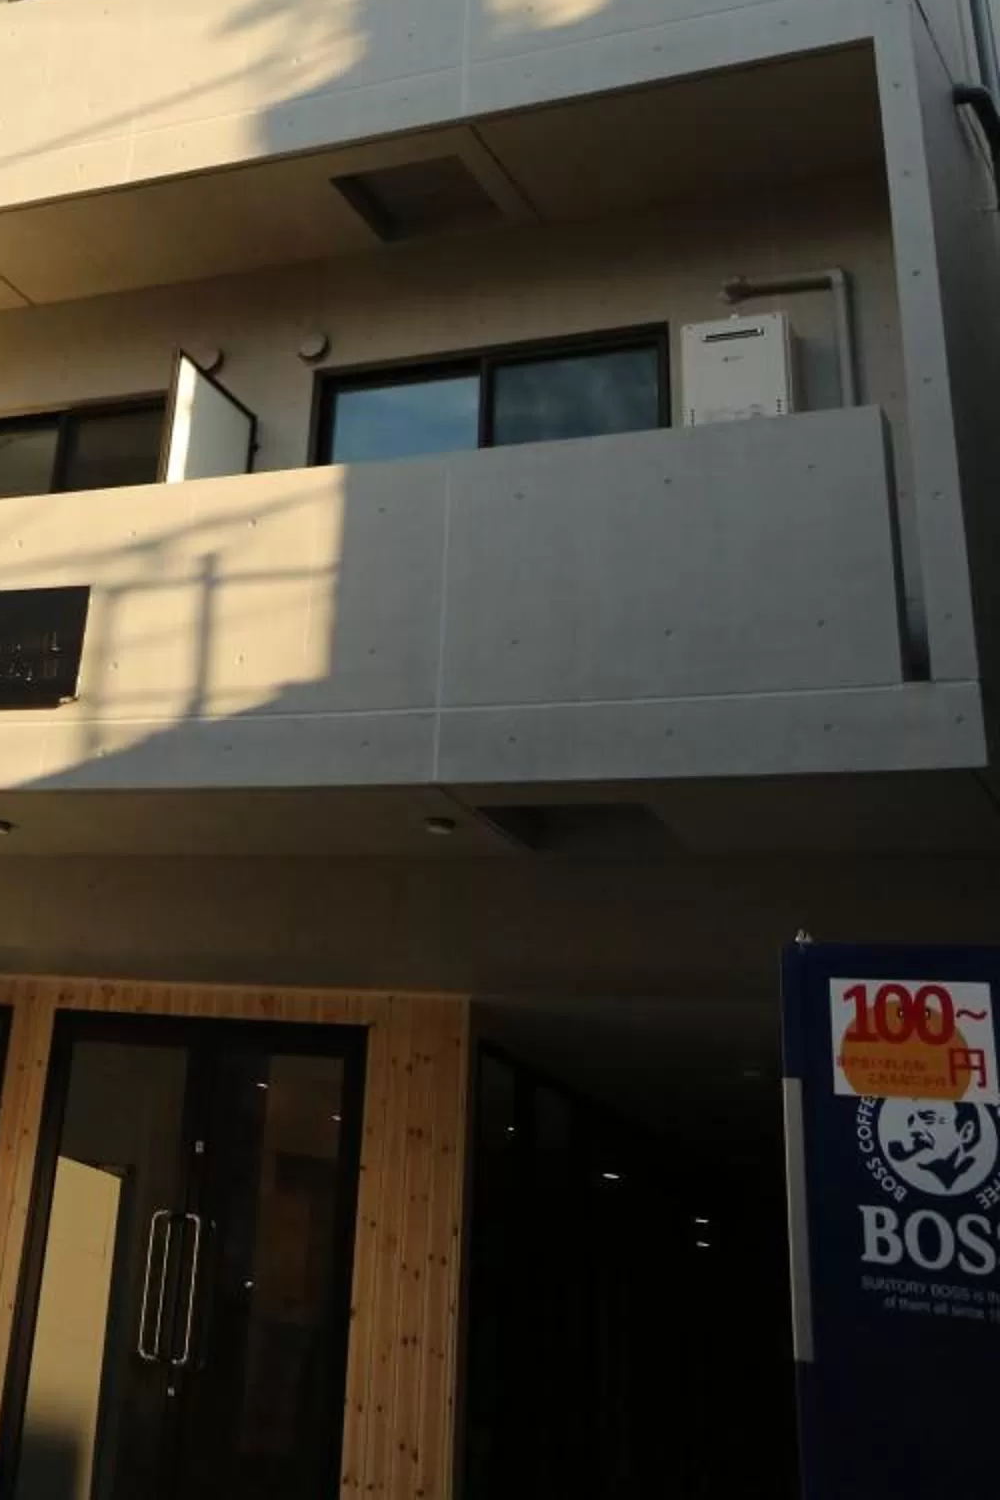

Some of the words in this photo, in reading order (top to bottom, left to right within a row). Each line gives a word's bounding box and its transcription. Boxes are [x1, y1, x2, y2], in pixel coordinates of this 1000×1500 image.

[949, 1048, 987, 1088] 円
[856, 1096, 876, 1153] COFFE
[866, 1156, 908, 1203] BOSS
[857, 1204, 1000, 1275] BOS
